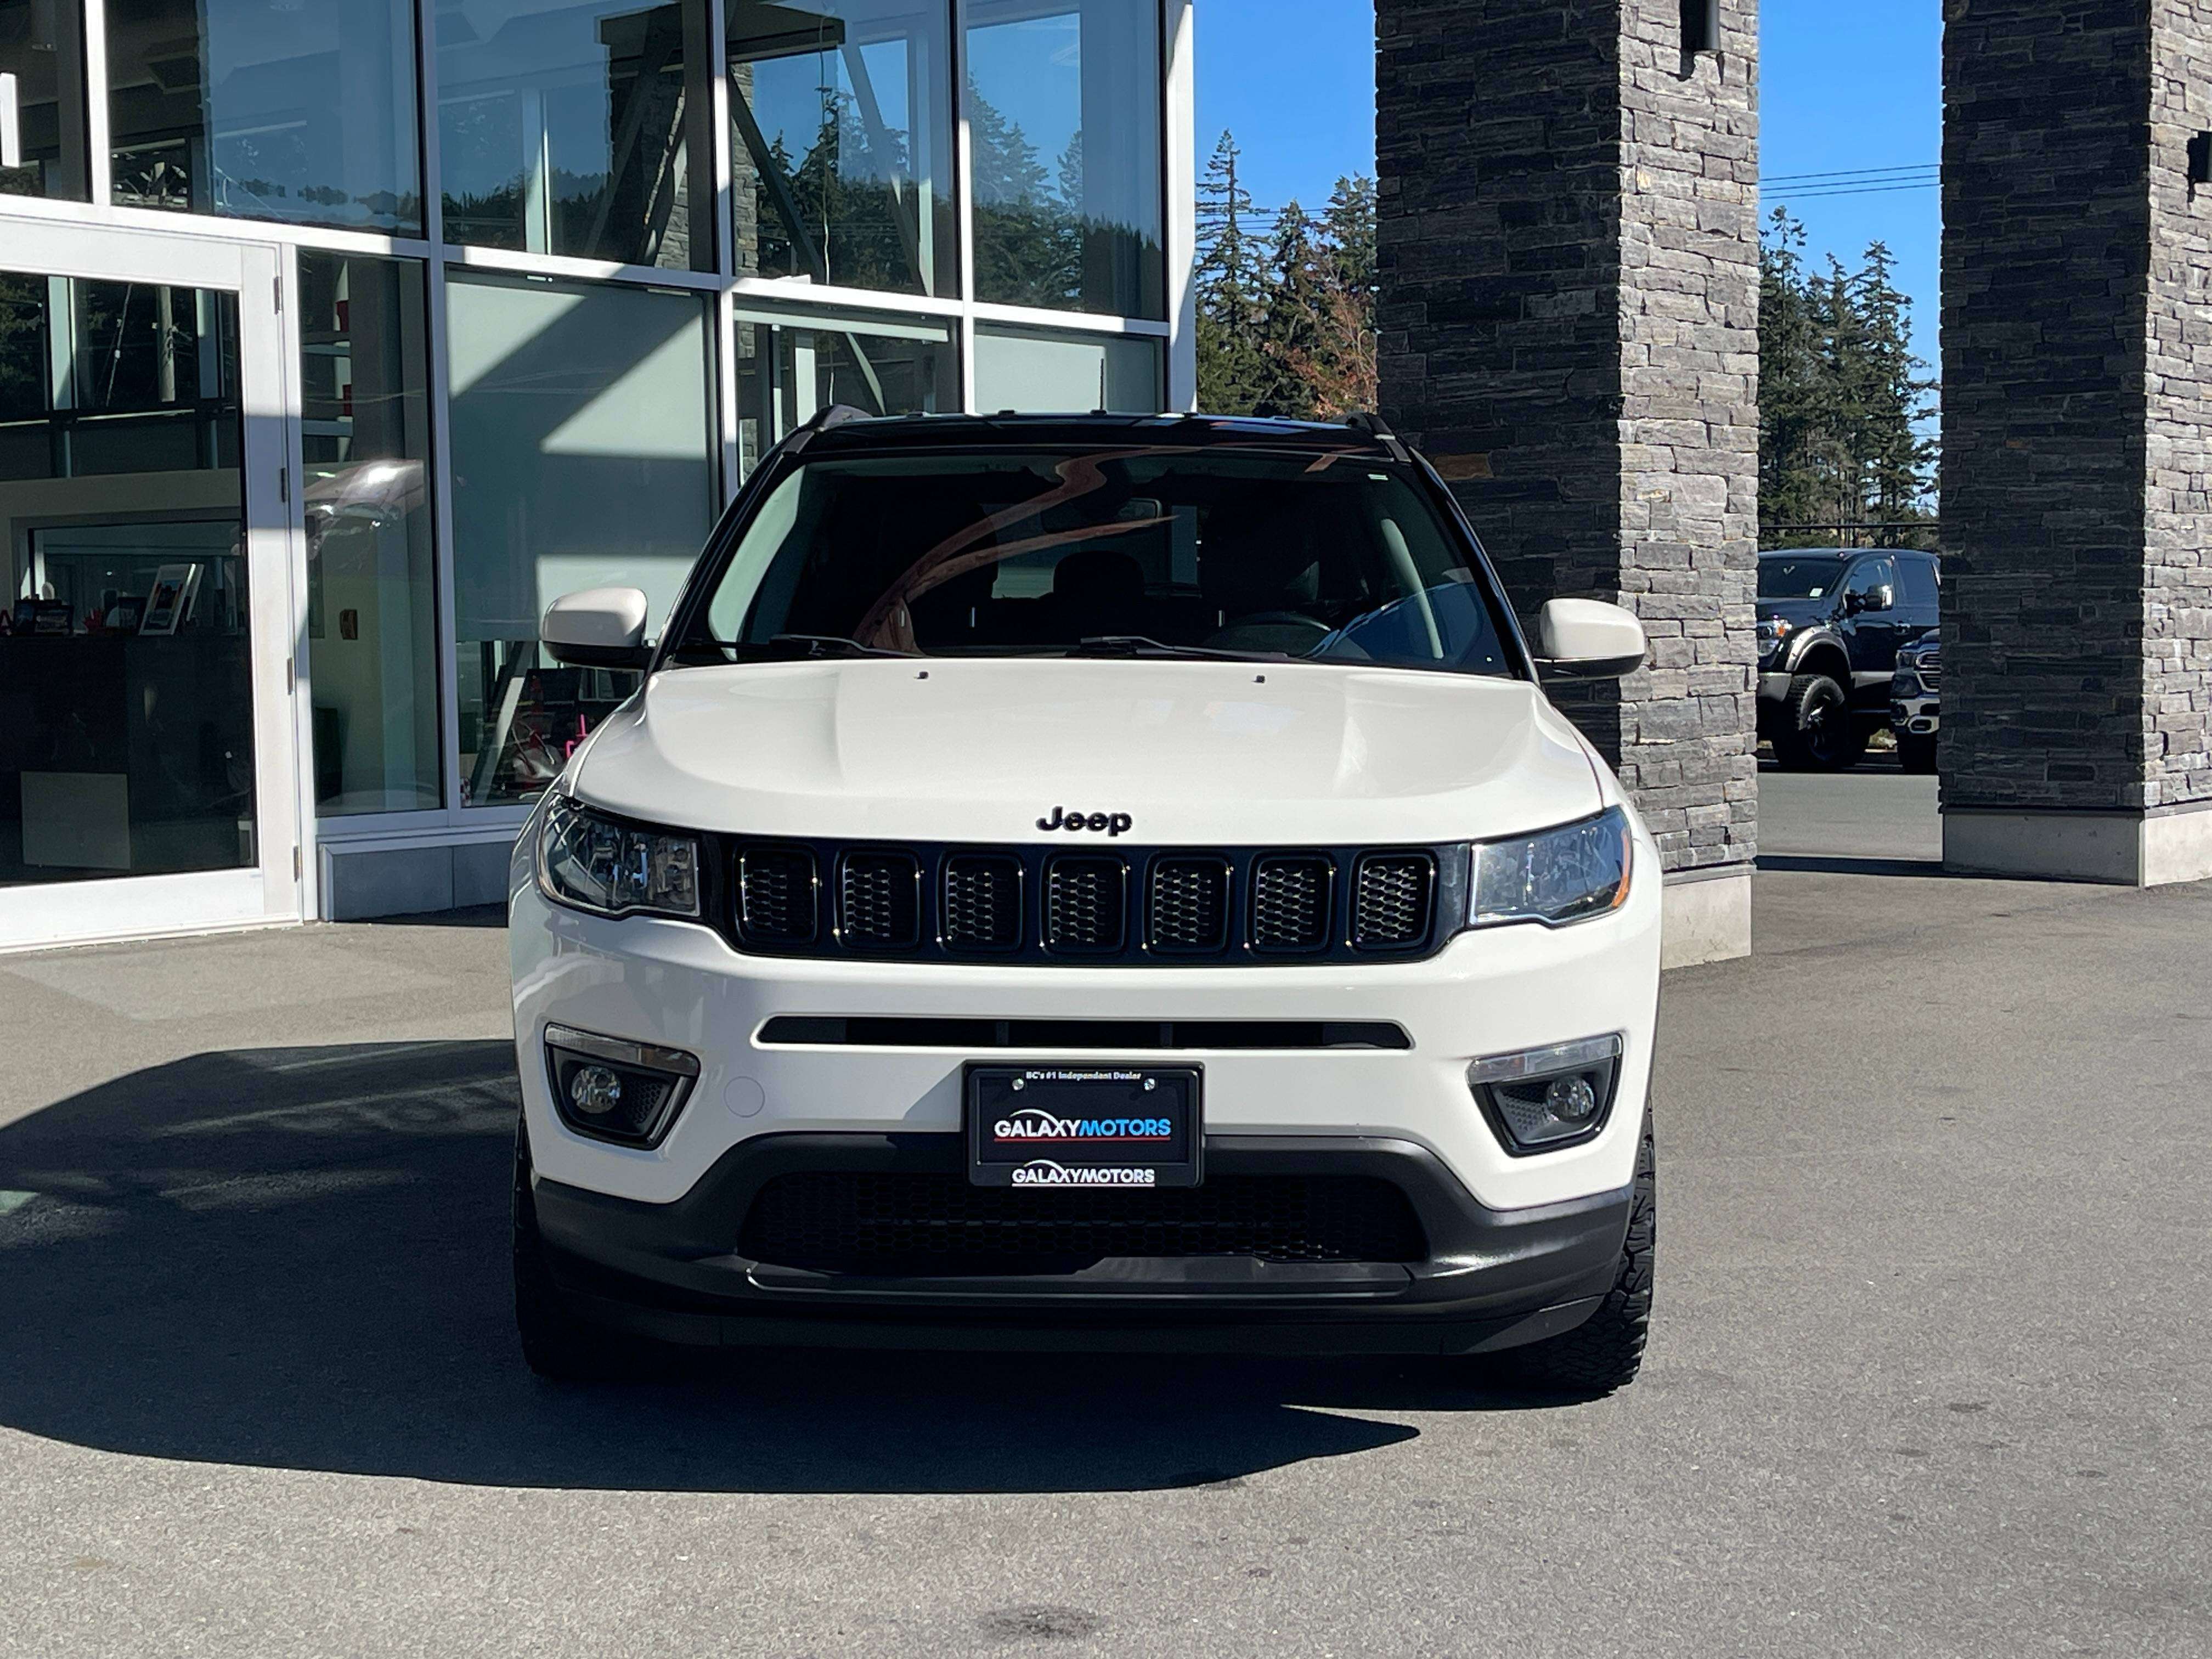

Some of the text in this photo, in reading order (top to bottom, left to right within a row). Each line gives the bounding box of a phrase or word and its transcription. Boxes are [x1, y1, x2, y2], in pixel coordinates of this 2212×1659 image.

[1035, 806, 1132, 837] Jeep
[1026, 1071, 1142, 1081] BC's #1 Independent Dealer
